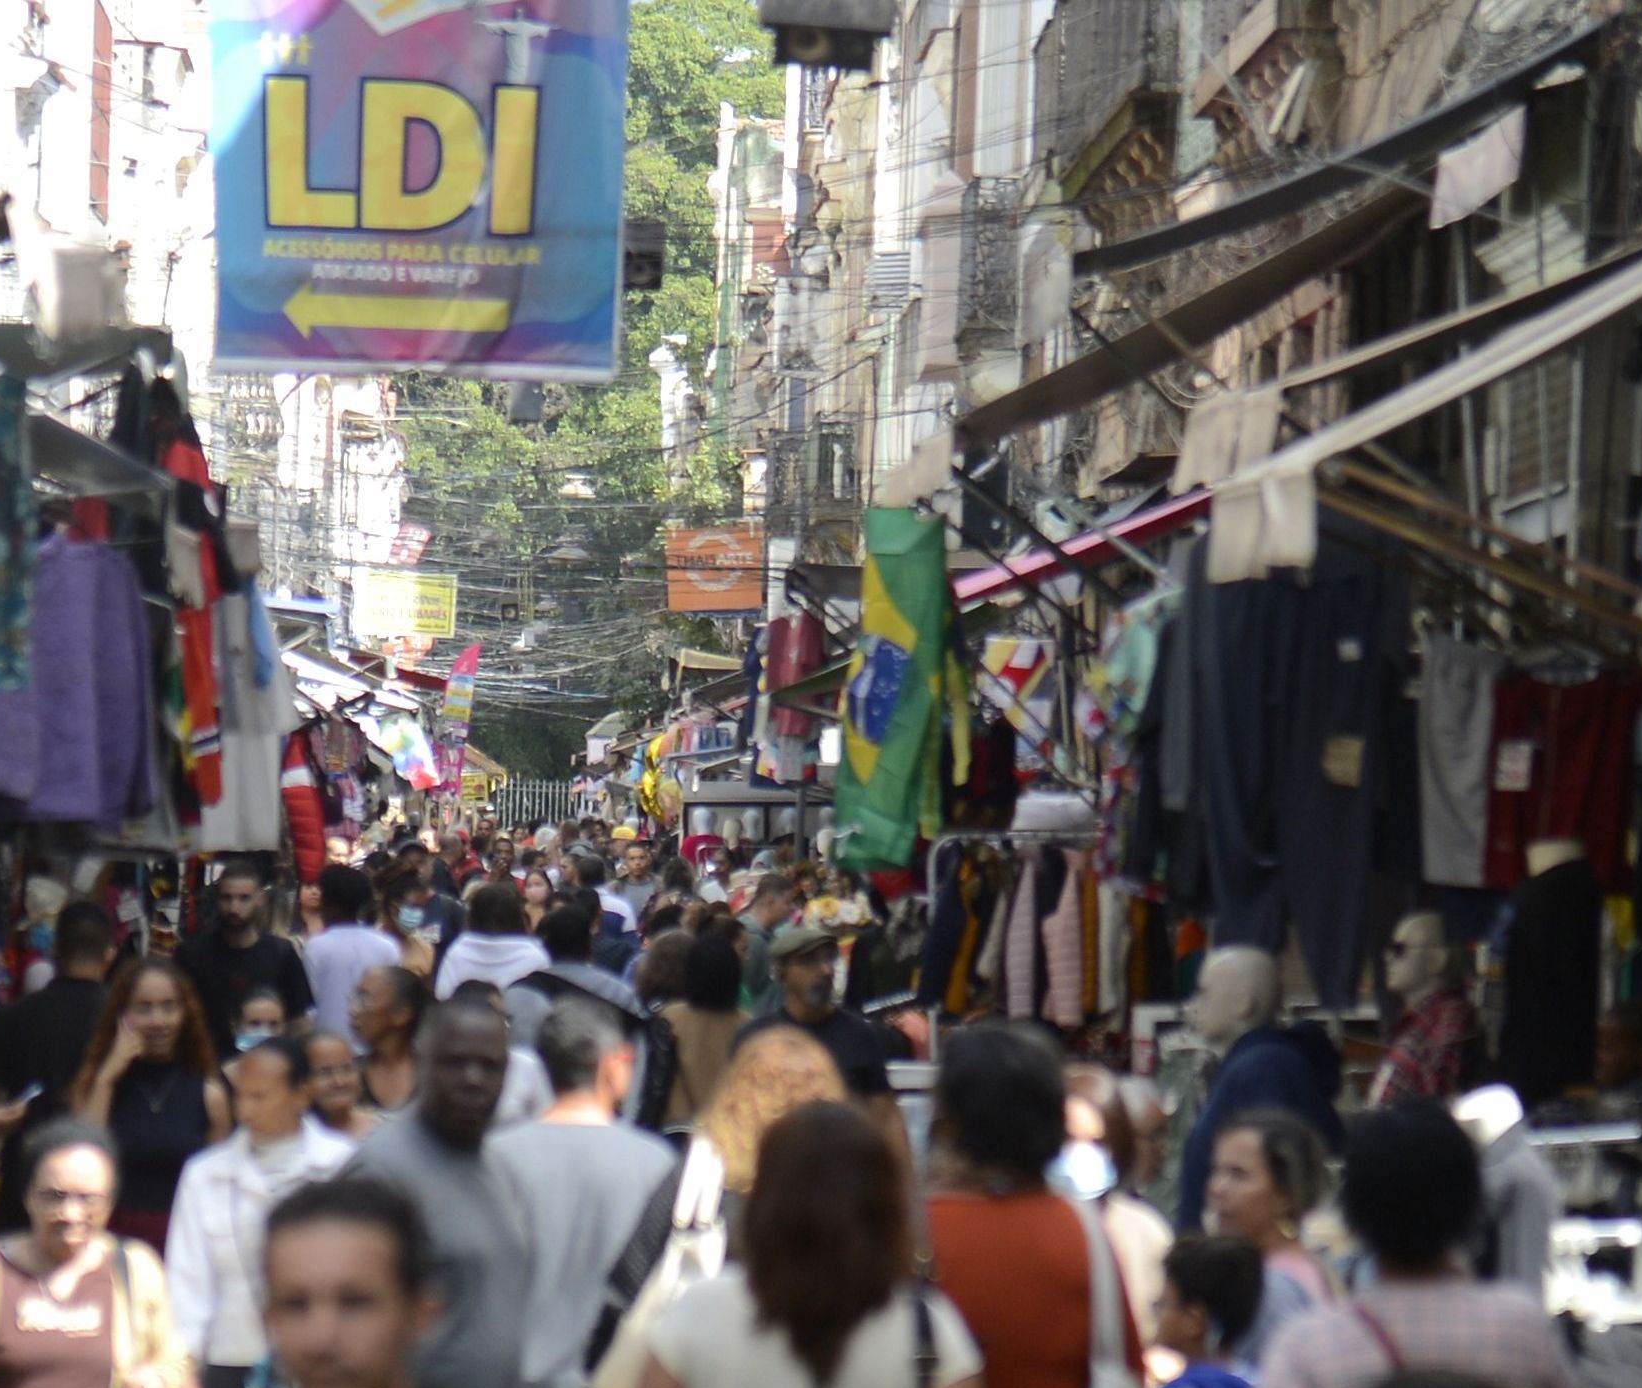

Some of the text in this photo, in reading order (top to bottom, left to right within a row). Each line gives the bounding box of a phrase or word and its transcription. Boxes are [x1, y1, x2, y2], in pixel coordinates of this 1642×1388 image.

[264, 73, 541, 237] LDI
[262, 238, 541, 265] ACESSÓRIOS PARA CELULAR
[311, 263, 479, 287] ATACADO E VAREJO
